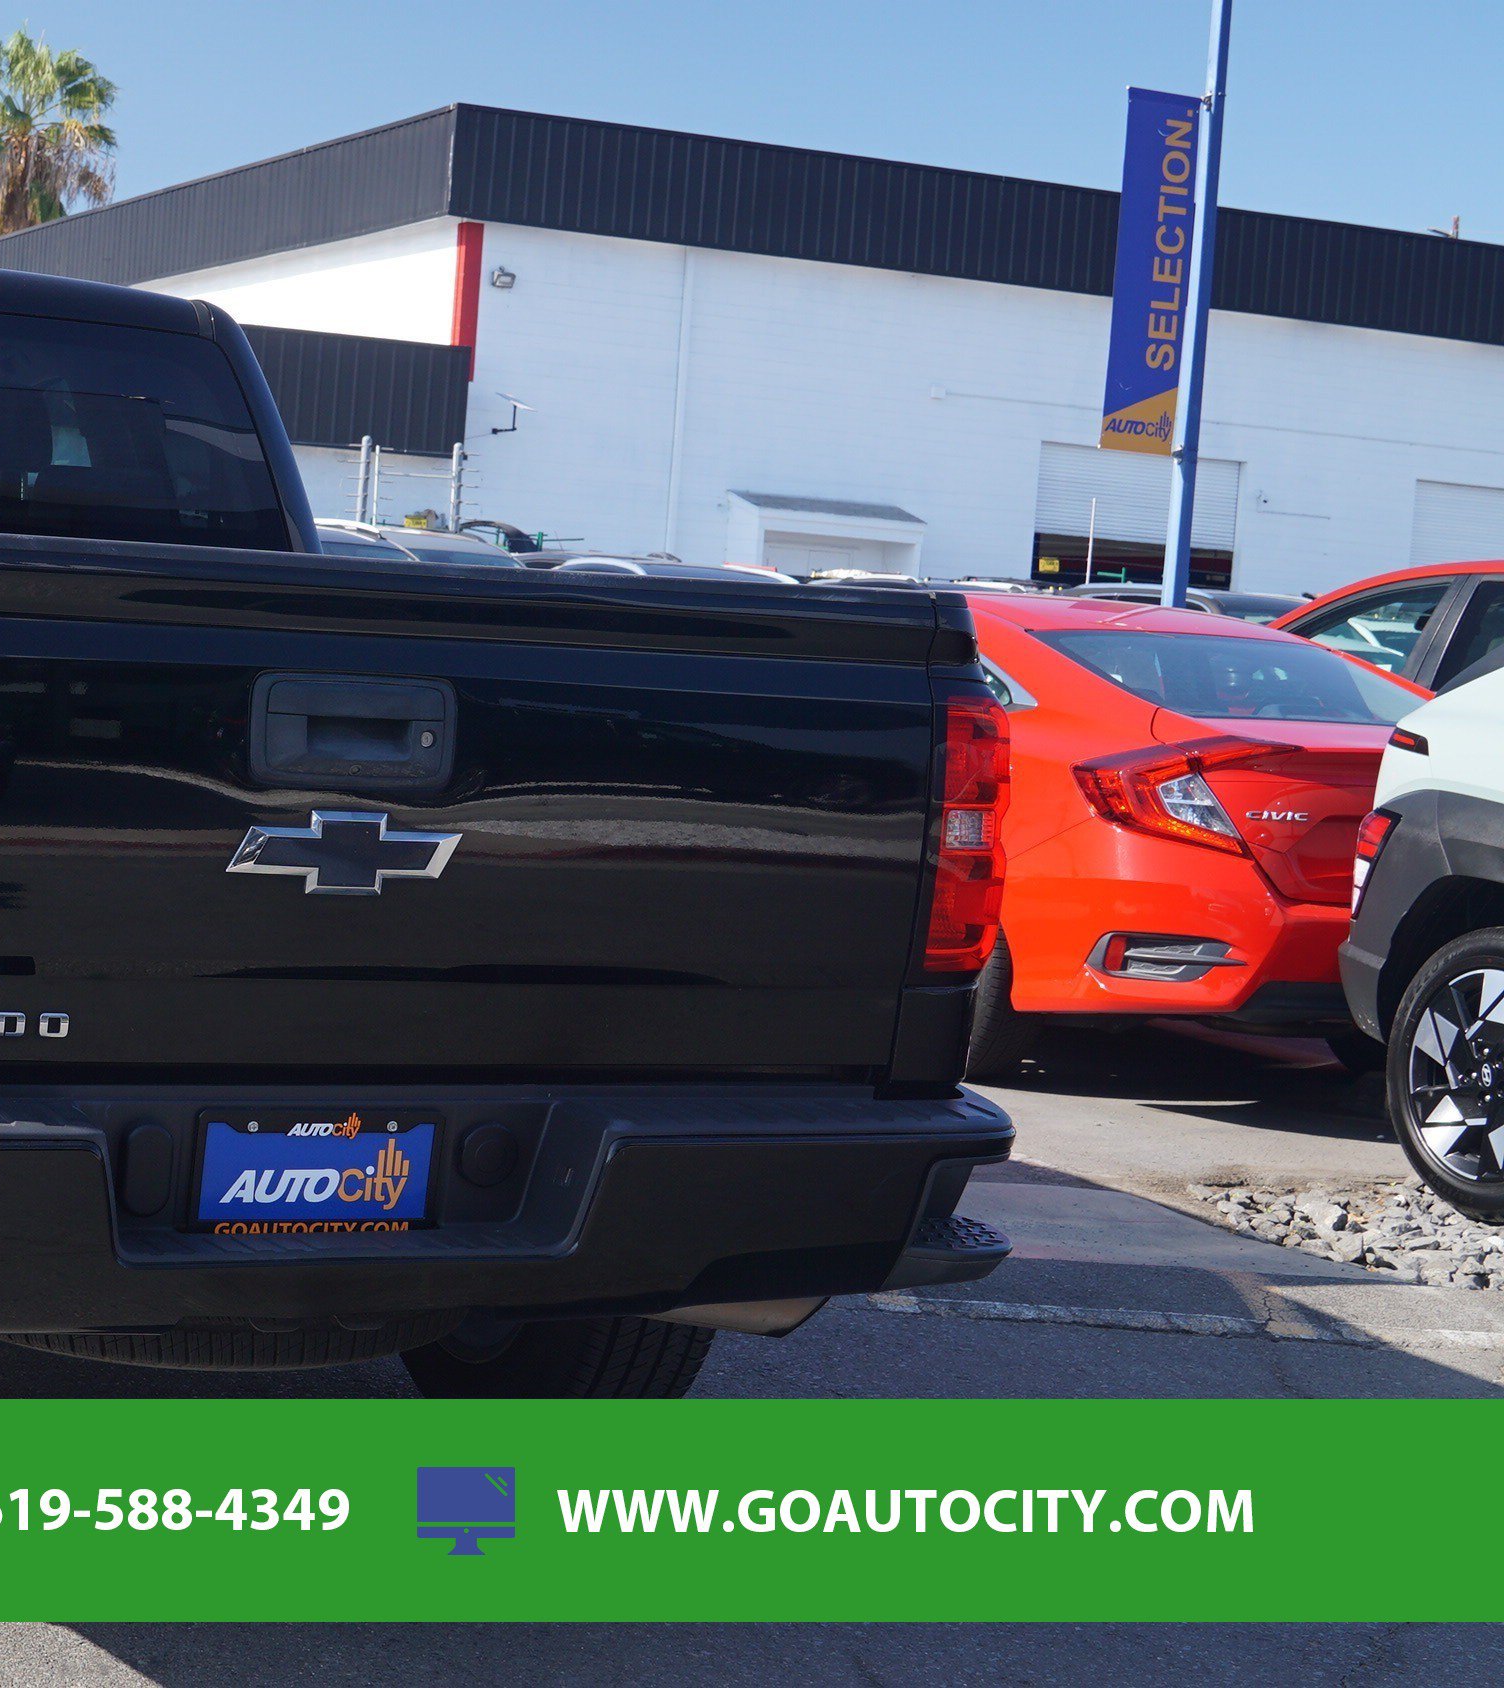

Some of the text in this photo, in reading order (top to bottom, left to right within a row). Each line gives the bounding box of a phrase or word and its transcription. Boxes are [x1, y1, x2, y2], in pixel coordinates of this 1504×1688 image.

[1145, 108, 1194, 371] SELECTION.
[1245, 810, 1309, 821] CIVIC
[287, 1115, 362, 1139] AUTOCity
[219, 1149, 410, 1210] AUTOCity
[214, 1221, 409, 1235] GOAUTOCITYCOM
